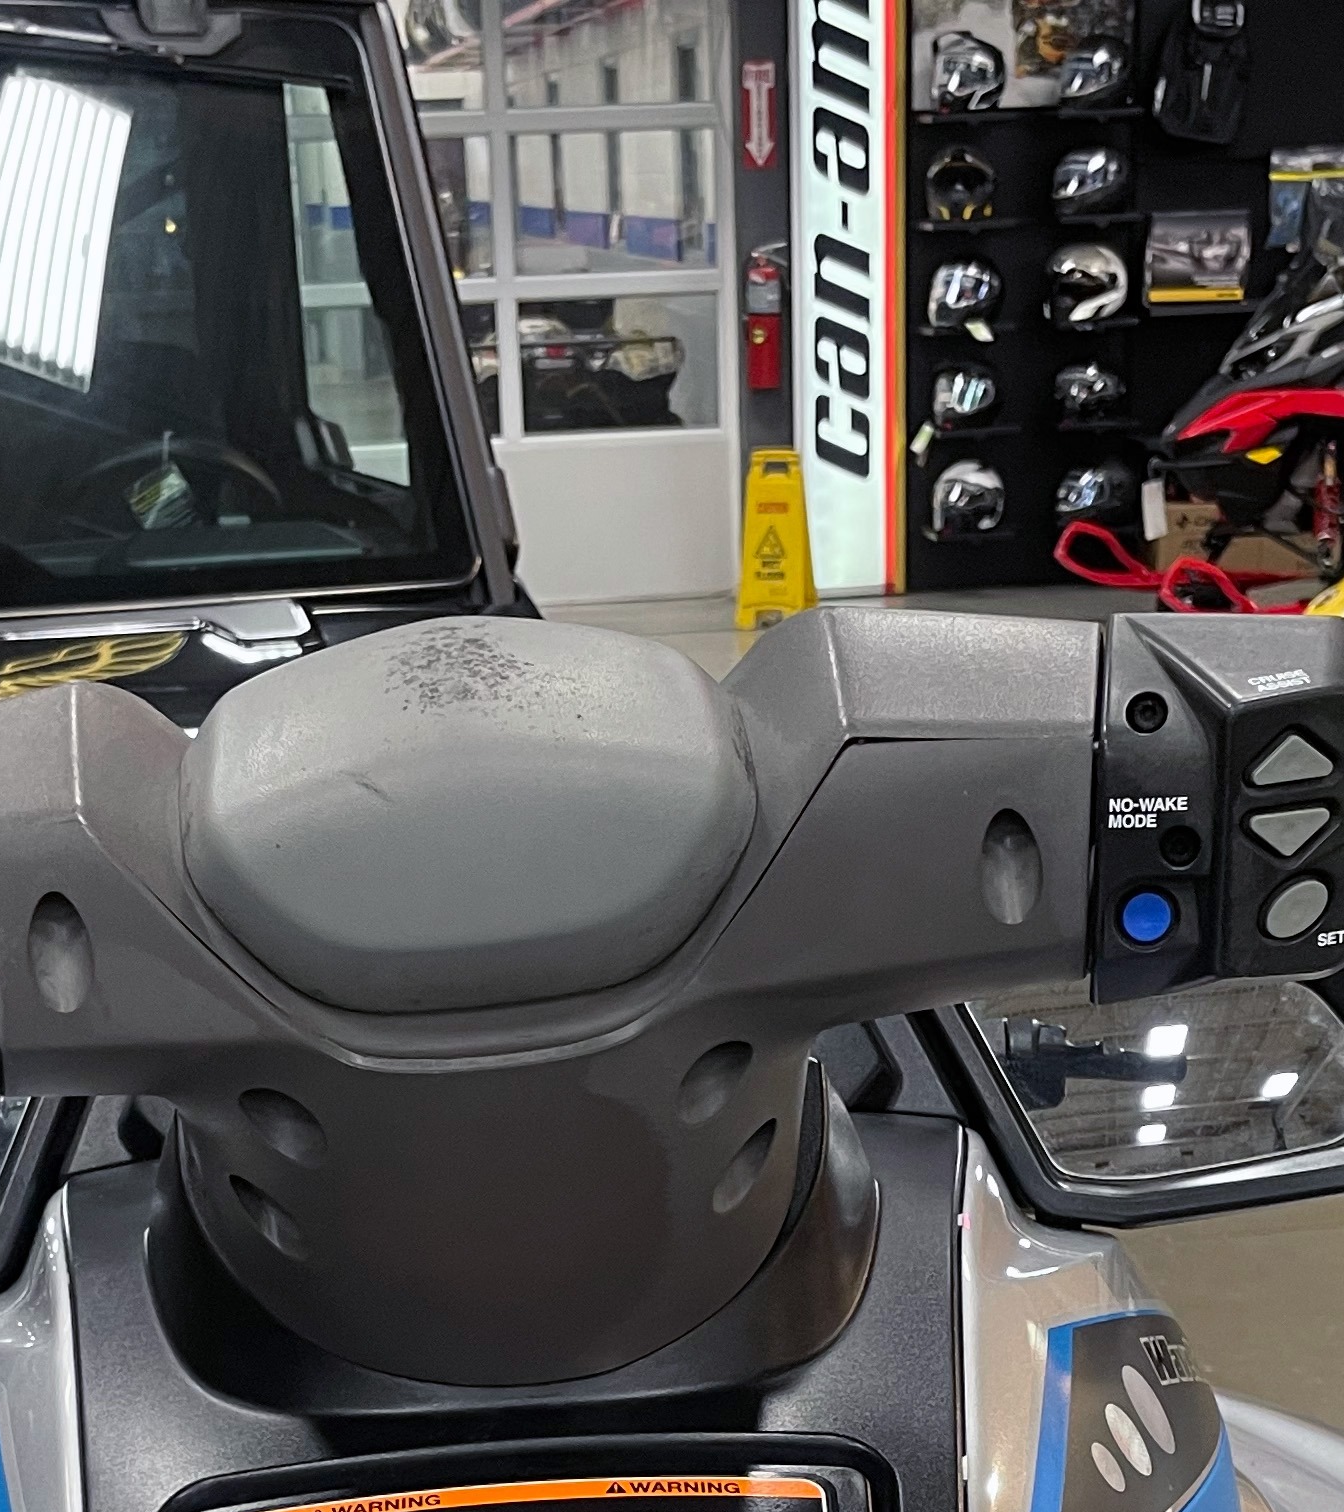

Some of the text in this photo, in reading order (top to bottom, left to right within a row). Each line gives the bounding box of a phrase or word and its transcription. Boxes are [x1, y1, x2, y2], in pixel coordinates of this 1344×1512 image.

[811, 0, 870, 478] can-am
[1258, 676, 1311, 692] ASSIST
[1108, 796, 1188, 813] NO-WAKE
[1108, 814, 1157, 829] MODE
[629, 1481, 741, 1494] WARNING
